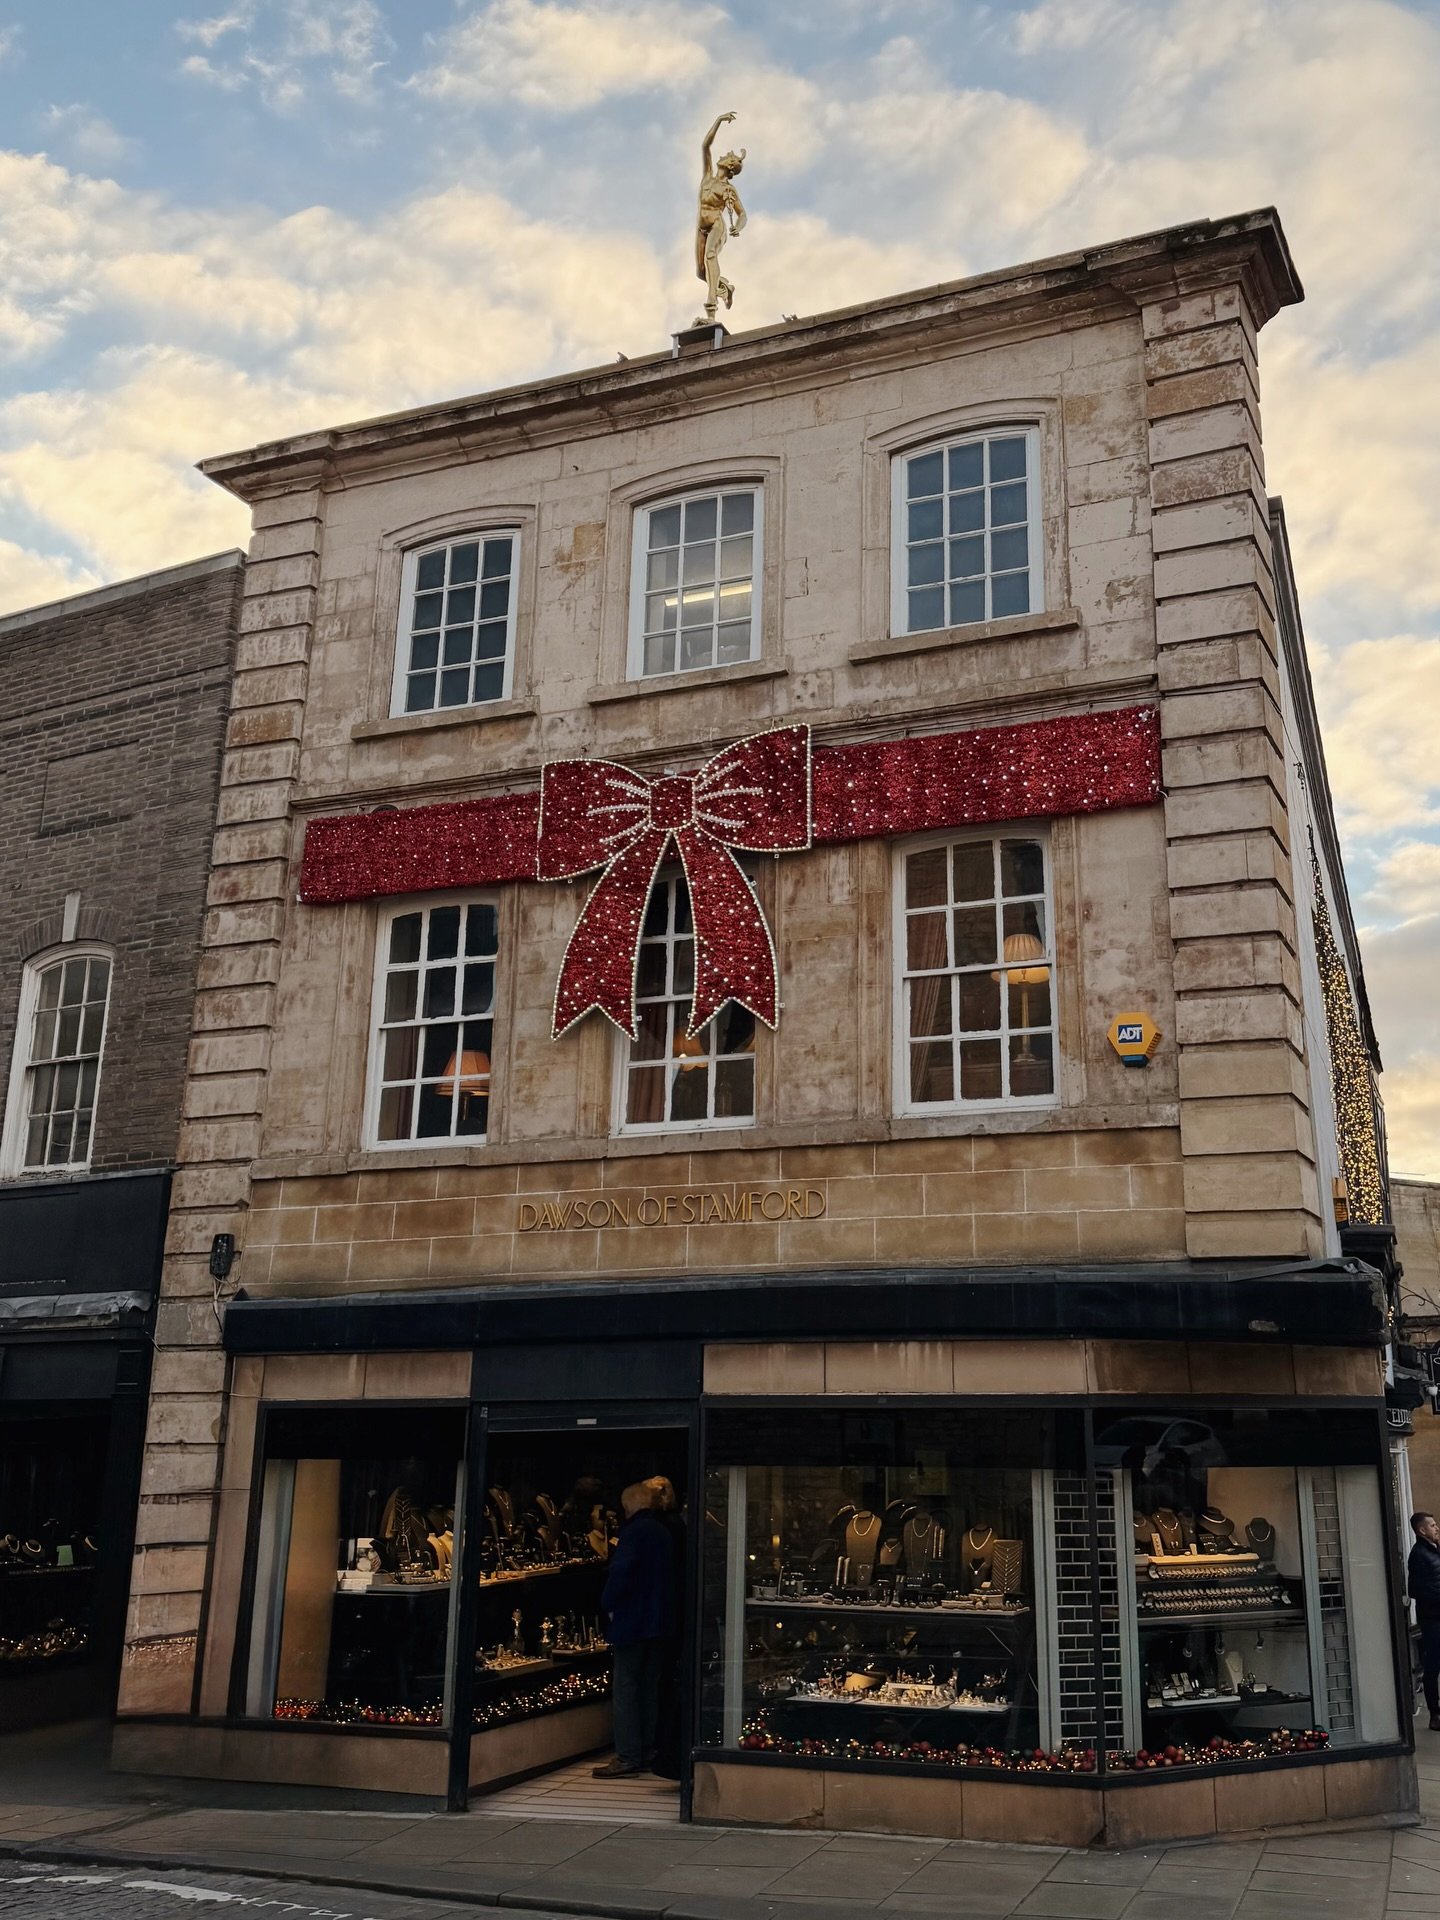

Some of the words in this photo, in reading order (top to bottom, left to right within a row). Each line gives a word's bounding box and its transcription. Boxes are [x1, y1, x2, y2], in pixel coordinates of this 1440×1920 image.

[1118, 1026, 1142, 1040] ADT
[519, 1198, 630, 1231] DAWSON
[637, 1196, 677, 1225] OF
[682, 1189, 826, 1223] STAMFORD
